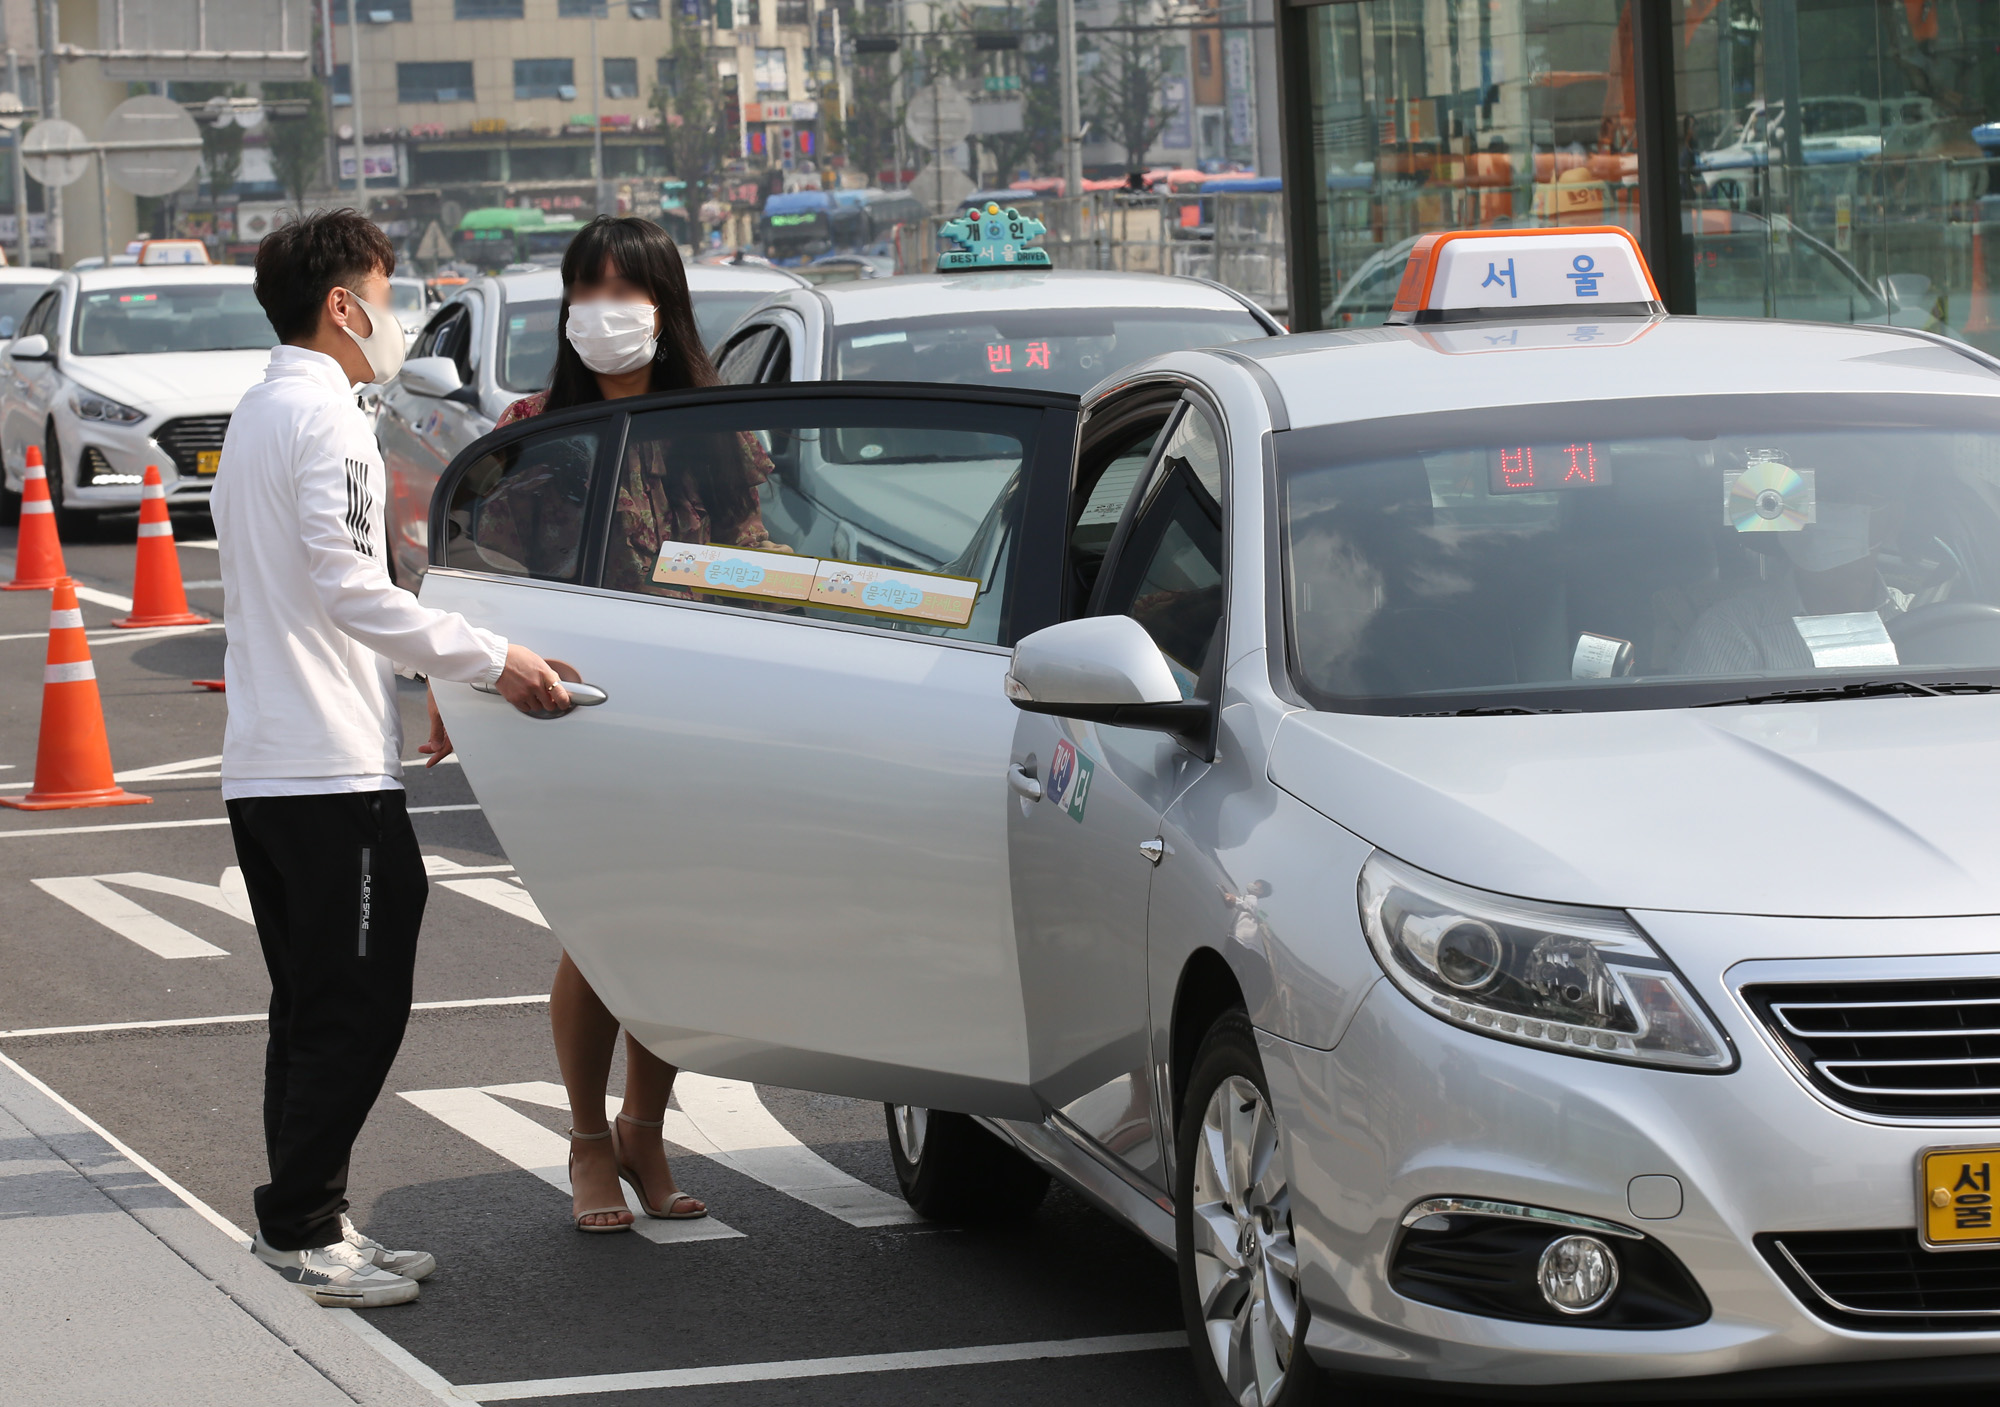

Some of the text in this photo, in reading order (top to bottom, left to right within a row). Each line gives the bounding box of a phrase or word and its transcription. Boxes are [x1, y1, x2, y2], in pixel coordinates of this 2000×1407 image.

[950, 254, 979, 263] BEST
[1017, 252, 1046, 261] DRIVER
[1953, 1162, 1992, 1229] 서울
